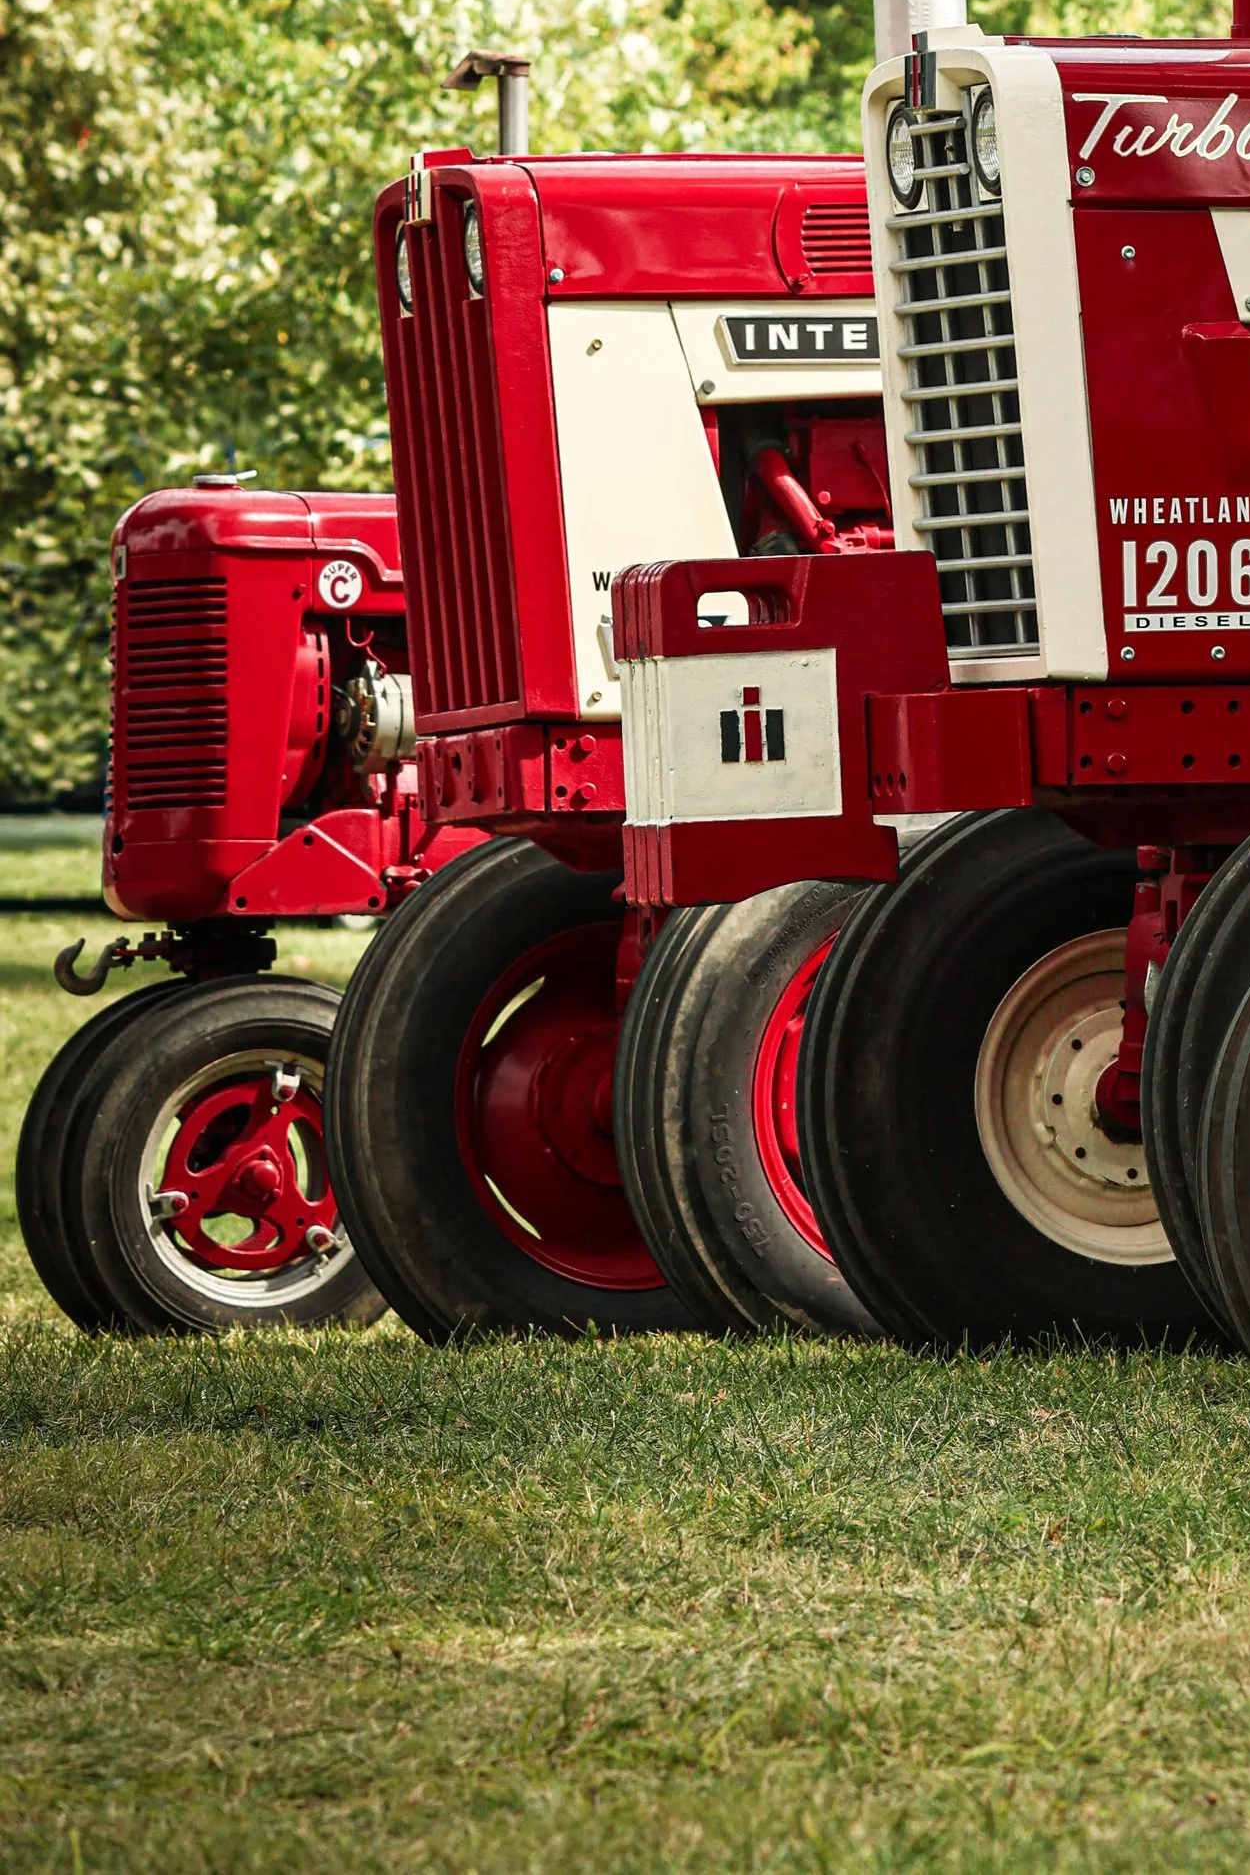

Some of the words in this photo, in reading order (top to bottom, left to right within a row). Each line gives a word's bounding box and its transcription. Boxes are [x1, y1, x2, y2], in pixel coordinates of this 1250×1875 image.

[745, 323, 869, 351] INTE
[323, 563, 358, 581] SUPER
[330, 575, 350, 603] C
